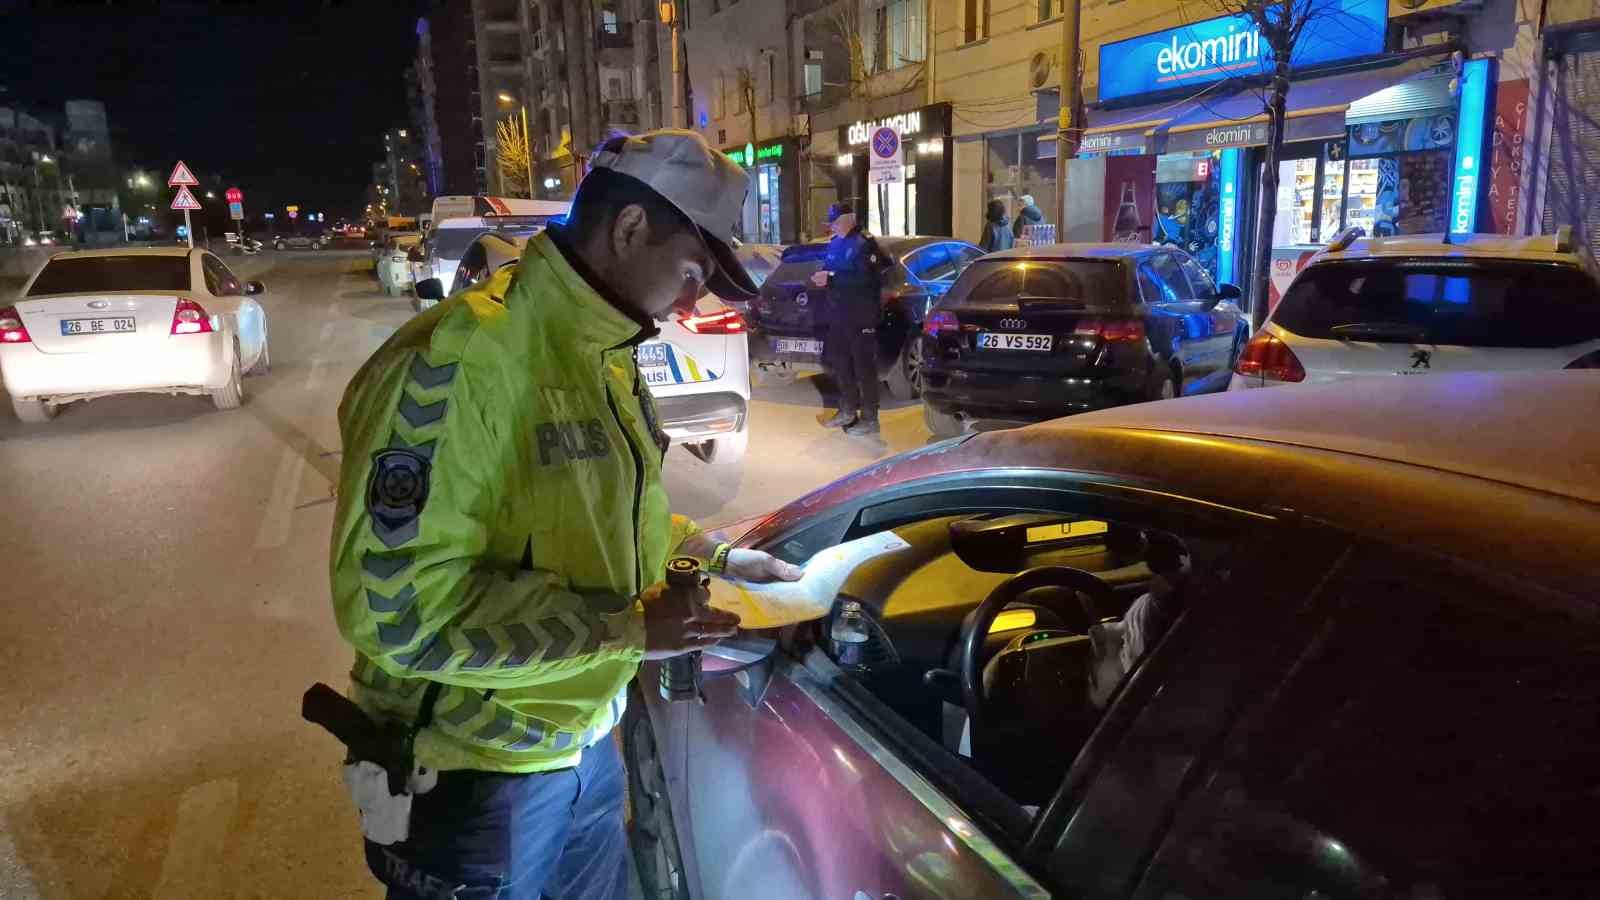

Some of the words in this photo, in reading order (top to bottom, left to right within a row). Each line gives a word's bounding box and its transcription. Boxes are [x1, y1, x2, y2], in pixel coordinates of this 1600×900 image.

[1157, 22, 1259, 74] ekomini
[1206, 125, 1251, 146] ekomini
[69, 321, 81, 332] 26
[113, 319, 133, 330] 024
[983, 335, 998, 347] 26
[1005, 335, 1023, 348] VS
[1025, 336, 1050, 349] 592
